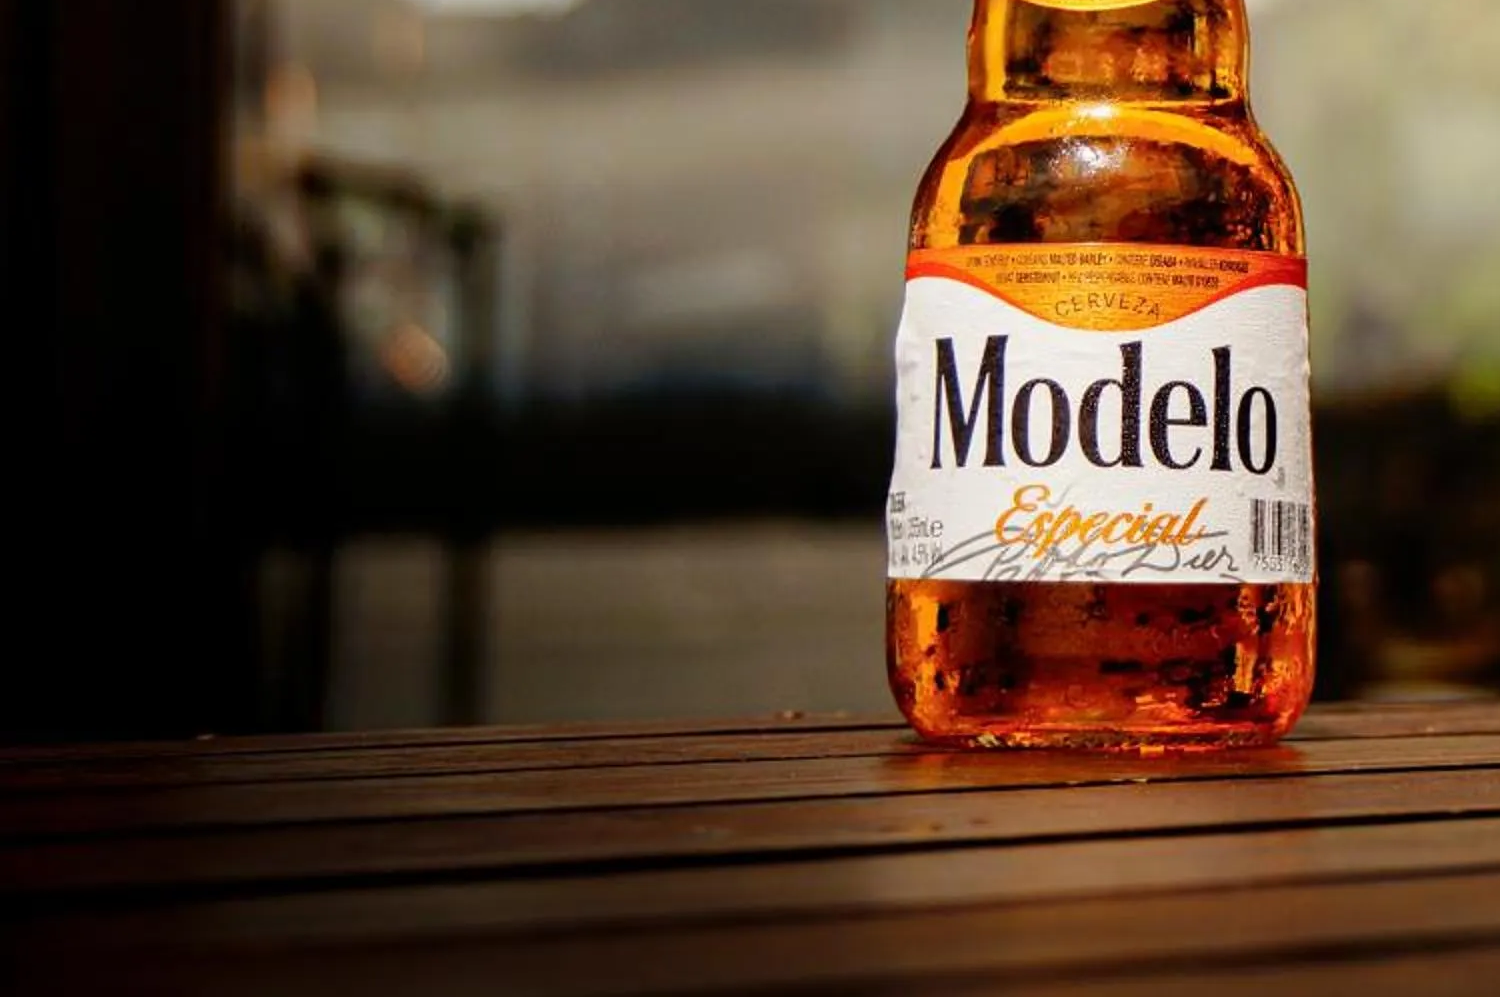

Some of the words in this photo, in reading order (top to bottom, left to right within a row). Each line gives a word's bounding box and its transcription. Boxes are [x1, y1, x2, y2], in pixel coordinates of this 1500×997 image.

[1054, 291, 1161, 319] CERVEZA
[929, 334, 1278, 476] Modelo
[994, 483, 1208, 560] Especial
